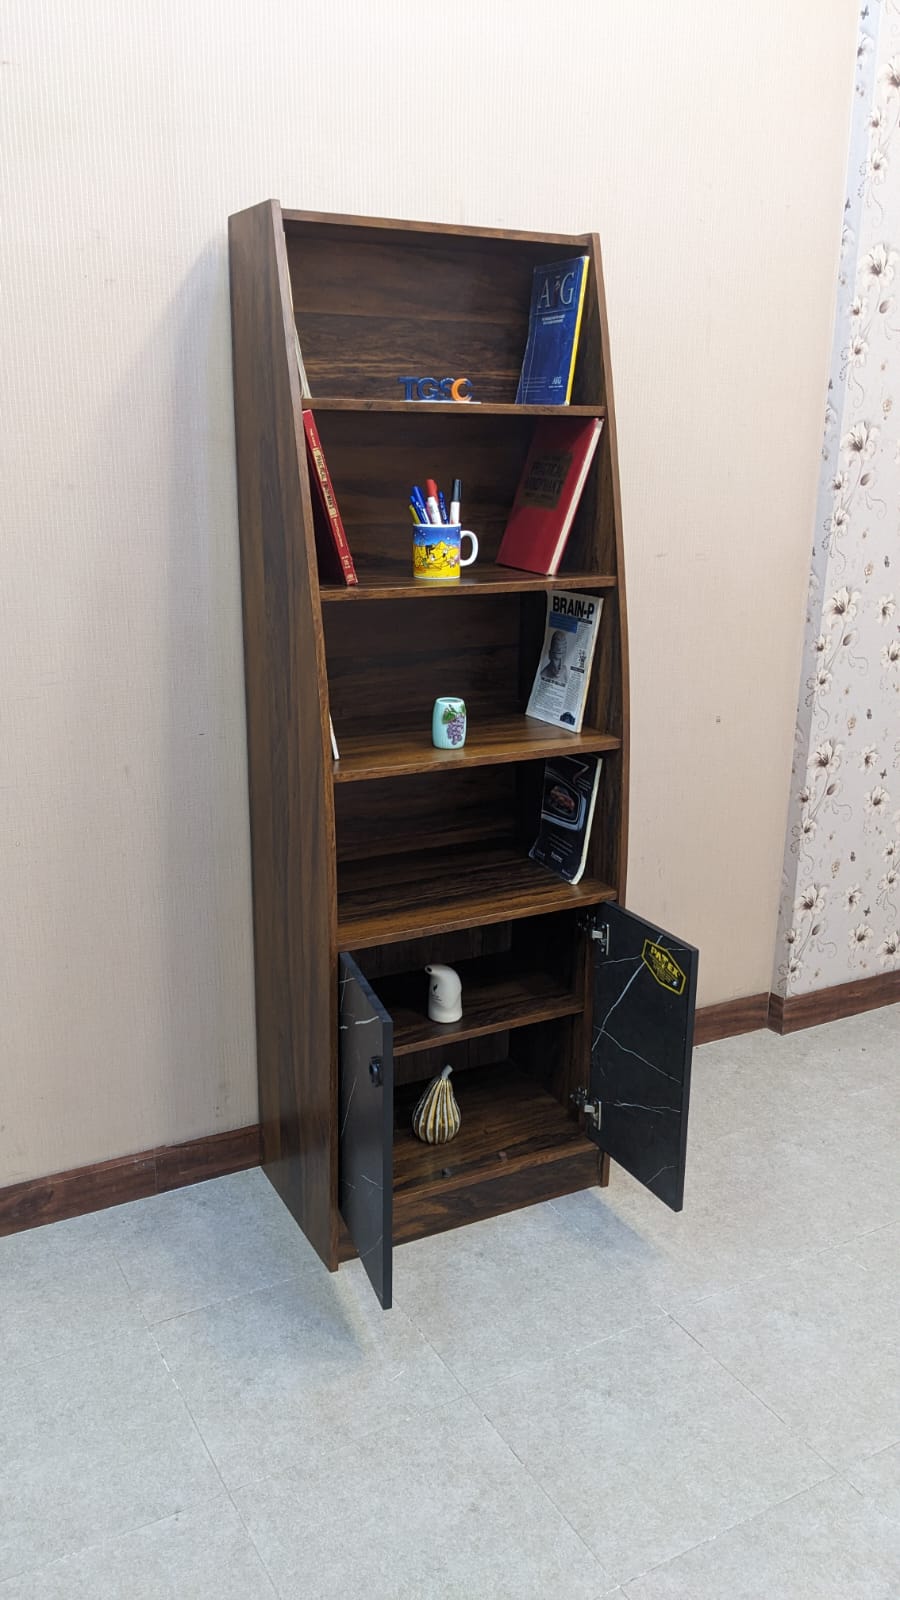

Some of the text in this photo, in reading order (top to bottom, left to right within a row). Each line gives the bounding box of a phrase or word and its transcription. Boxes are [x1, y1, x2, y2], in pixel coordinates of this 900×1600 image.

[397, 376, 473, 402] TGSC
[552, 596, 595, 619] BRAIN-P
[650, 945, 680, 978] PATEX
